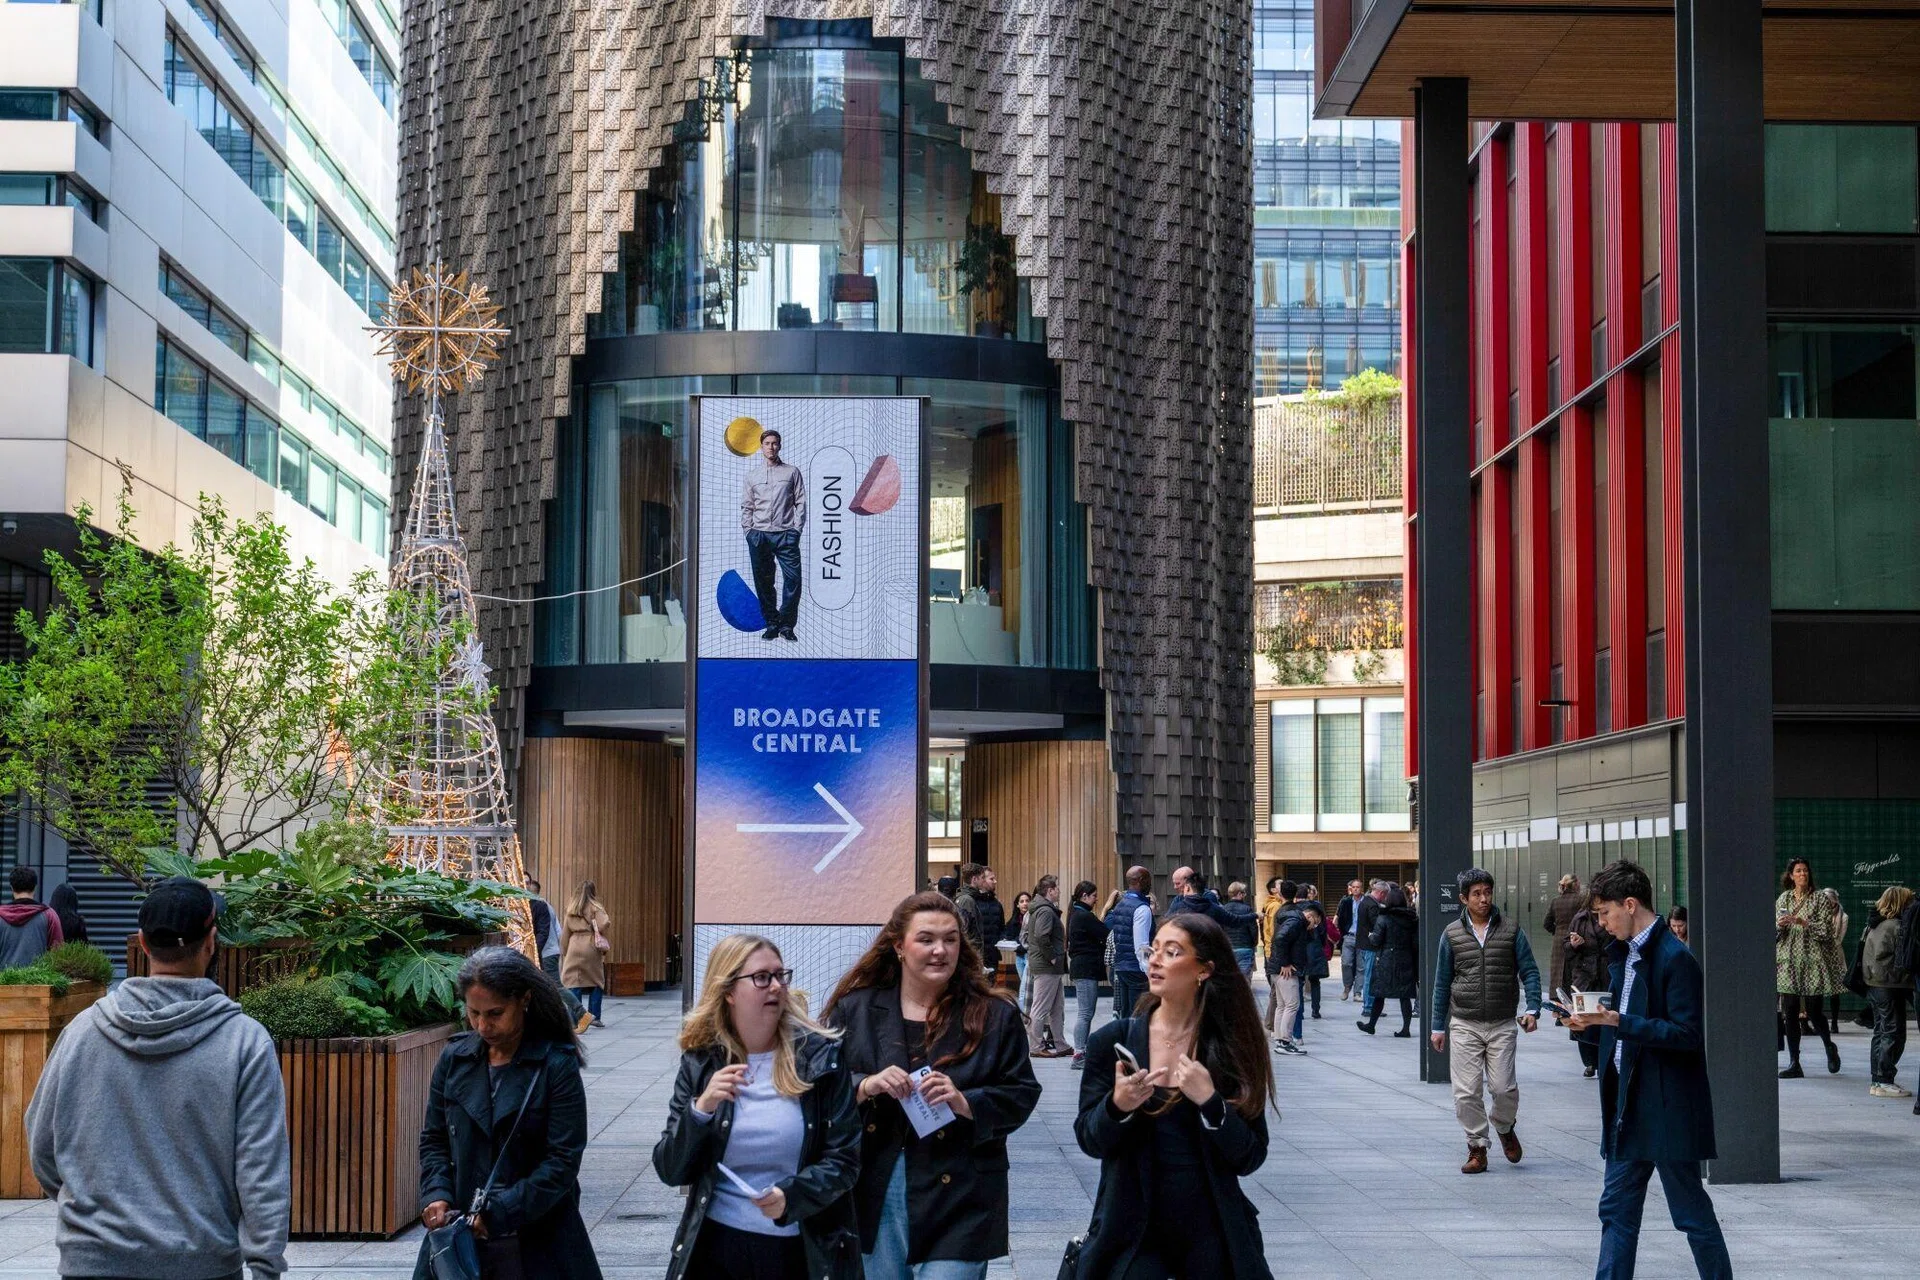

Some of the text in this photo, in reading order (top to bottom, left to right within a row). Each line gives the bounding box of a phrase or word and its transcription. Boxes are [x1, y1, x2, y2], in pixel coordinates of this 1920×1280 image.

[823, 475, 842, 580] FASHION
[733, 708, 881, 728] BROADGATE
[752, 733, 862, 753] CENTRAL
[911, 1091, 929, 1120] ENTRAL
